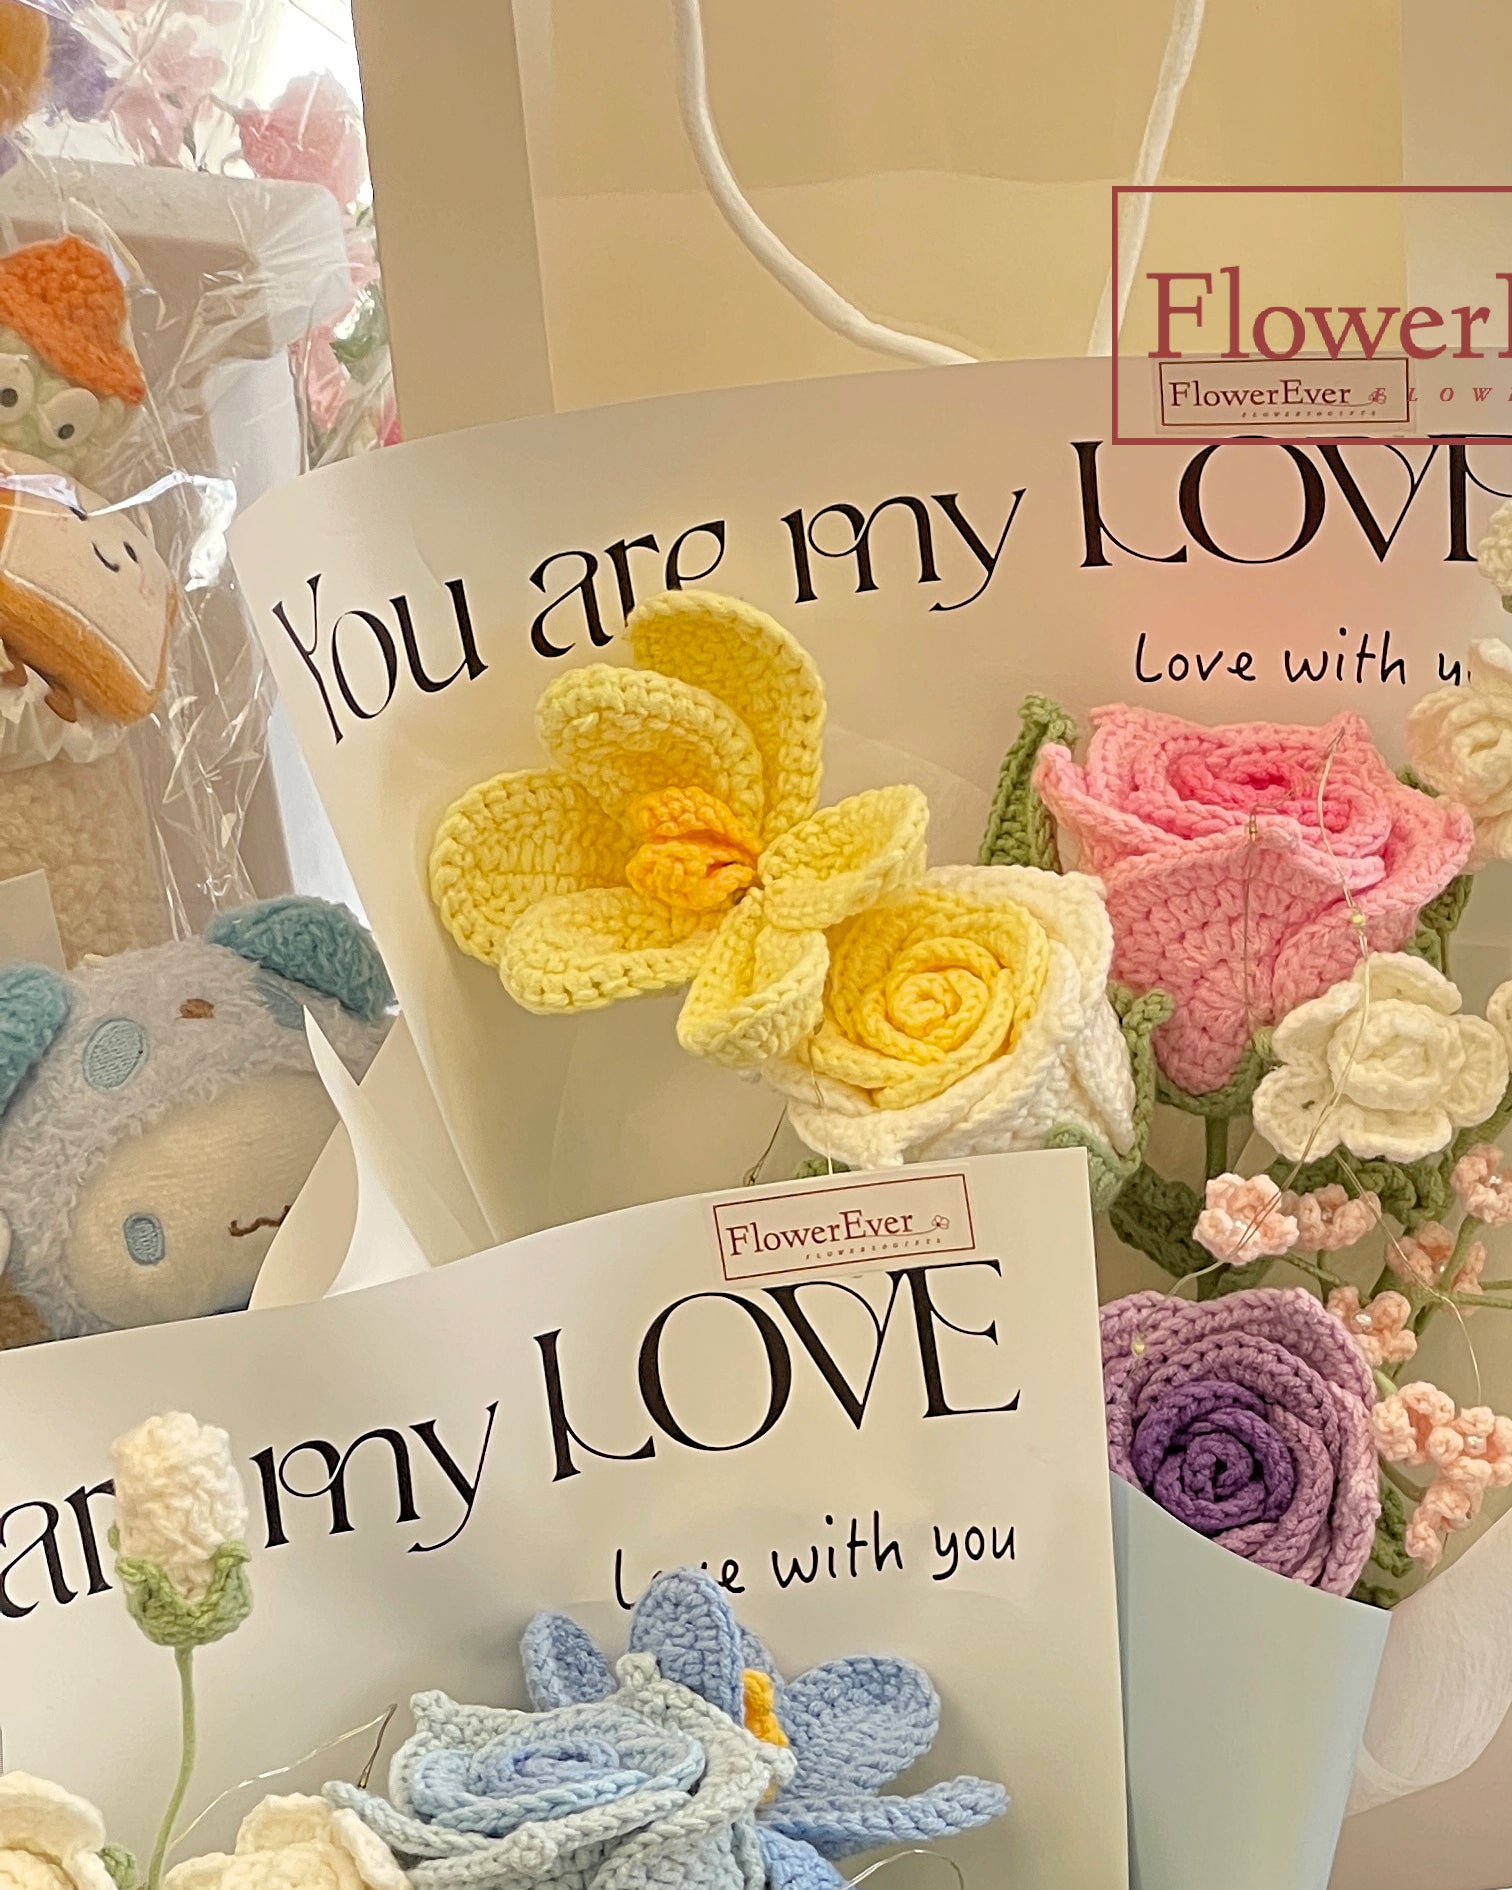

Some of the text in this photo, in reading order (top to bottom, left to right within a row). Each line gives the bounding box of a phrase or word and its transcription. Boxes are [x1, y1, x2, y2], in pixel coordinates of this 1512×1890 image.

[1168, 379, 1352, 408] FlowerEver
[274, 573, 488, 744] You
[781, 487, 1027, 612] my
[1136, 632, 1257, 684] Love
[1283, 627, 1407, 685] with
[725, 1209, 913, 1256] FlowerEver
[0, 1259, 1021, 1618] ar my LOVE
[771, 1510, 904, 1588] with
[931, 1525, 1017, 1581] you
